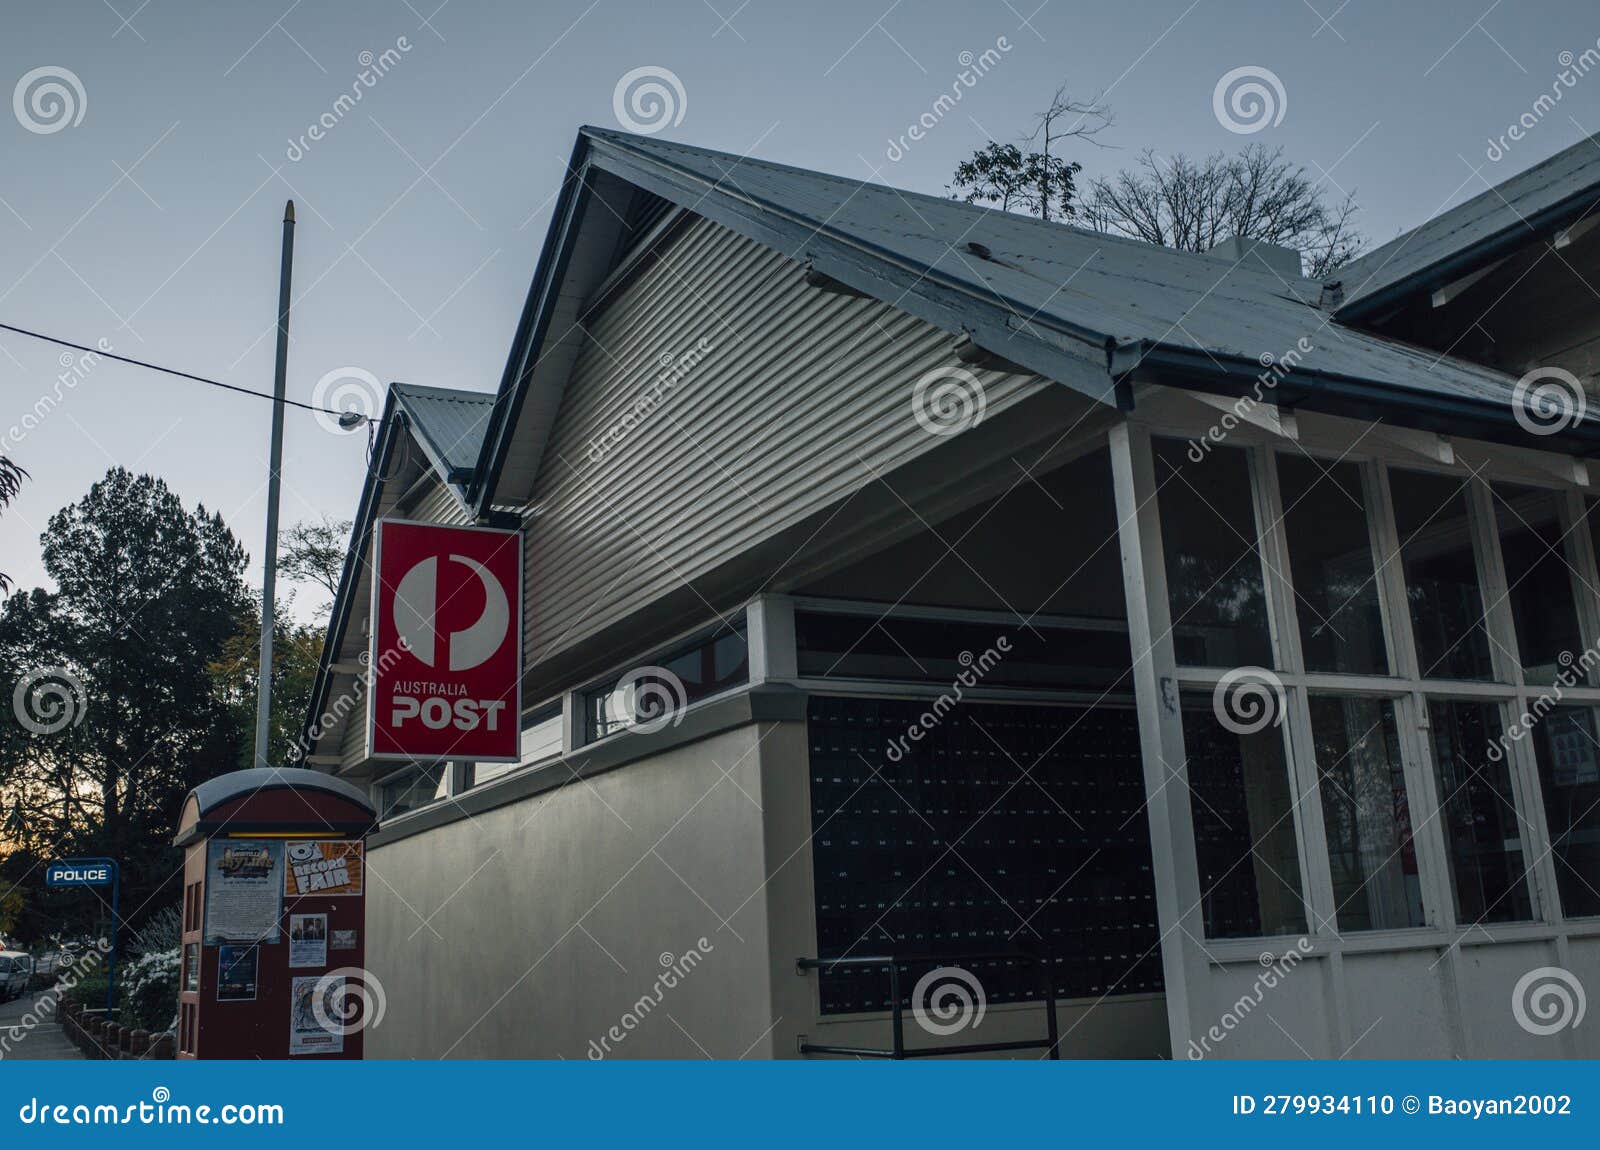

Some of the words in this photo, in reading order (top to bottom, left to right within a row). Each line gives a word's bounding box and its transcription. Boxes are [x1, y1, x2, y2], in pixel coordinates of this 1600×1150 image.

[393, 680, 468, 696] AUSTRALIA
[391, 696, 506, 731] POST
[53, 869, 107, 881] POLICE
[296, 868, 352, 894] FAIR
